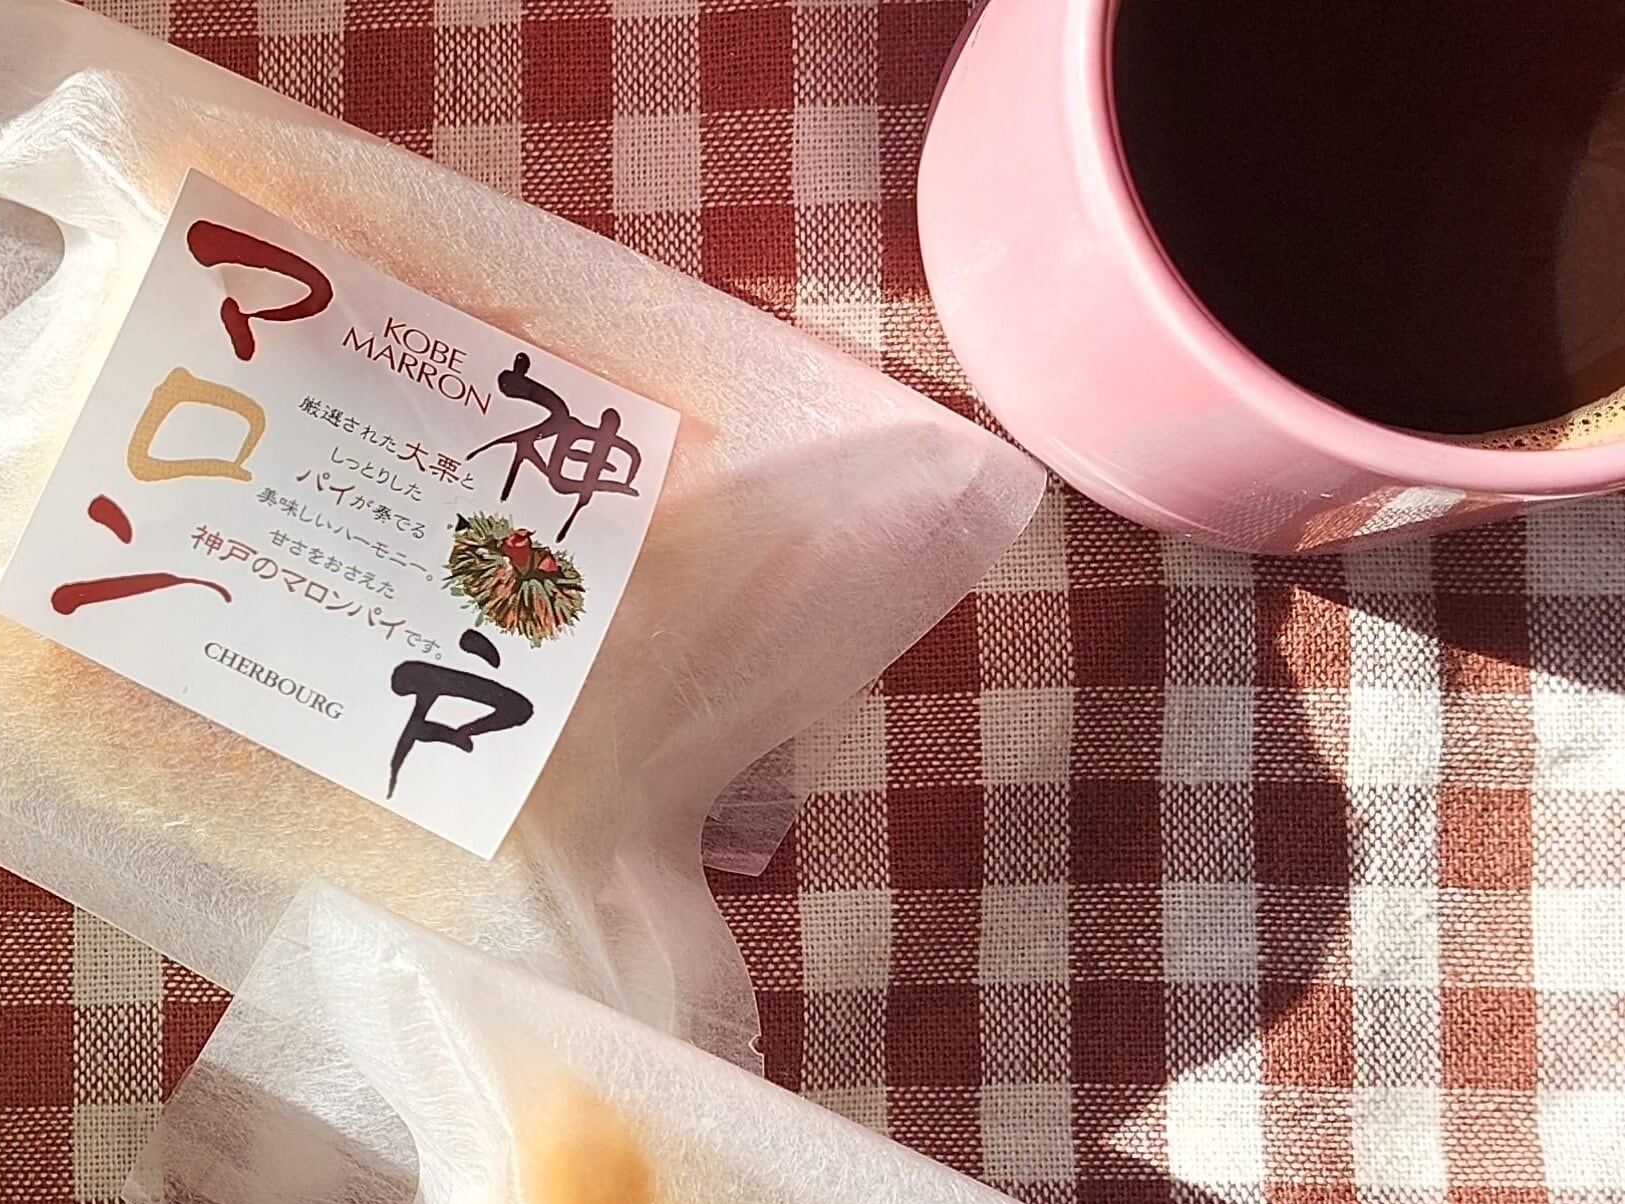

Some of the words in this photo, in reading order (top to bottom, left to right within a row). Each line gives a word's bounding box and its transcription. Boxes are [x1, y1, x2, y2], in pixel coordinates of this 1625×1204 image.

[341, 326, 493, 416] MARRON
[383, 316, 468, 375] KOBE
[297, 395, 476, 492] 厳選された大栗と
[330, 445, 424, 503] しっとりした
[295, 468, 426, 541] パイが奏でる
[189, 524, 443, 661] 神戸のマロンパイです。
[268, 528, 397, 601] 甘さをおさえた
[202, 640, 346, 721] CHERBOURG
